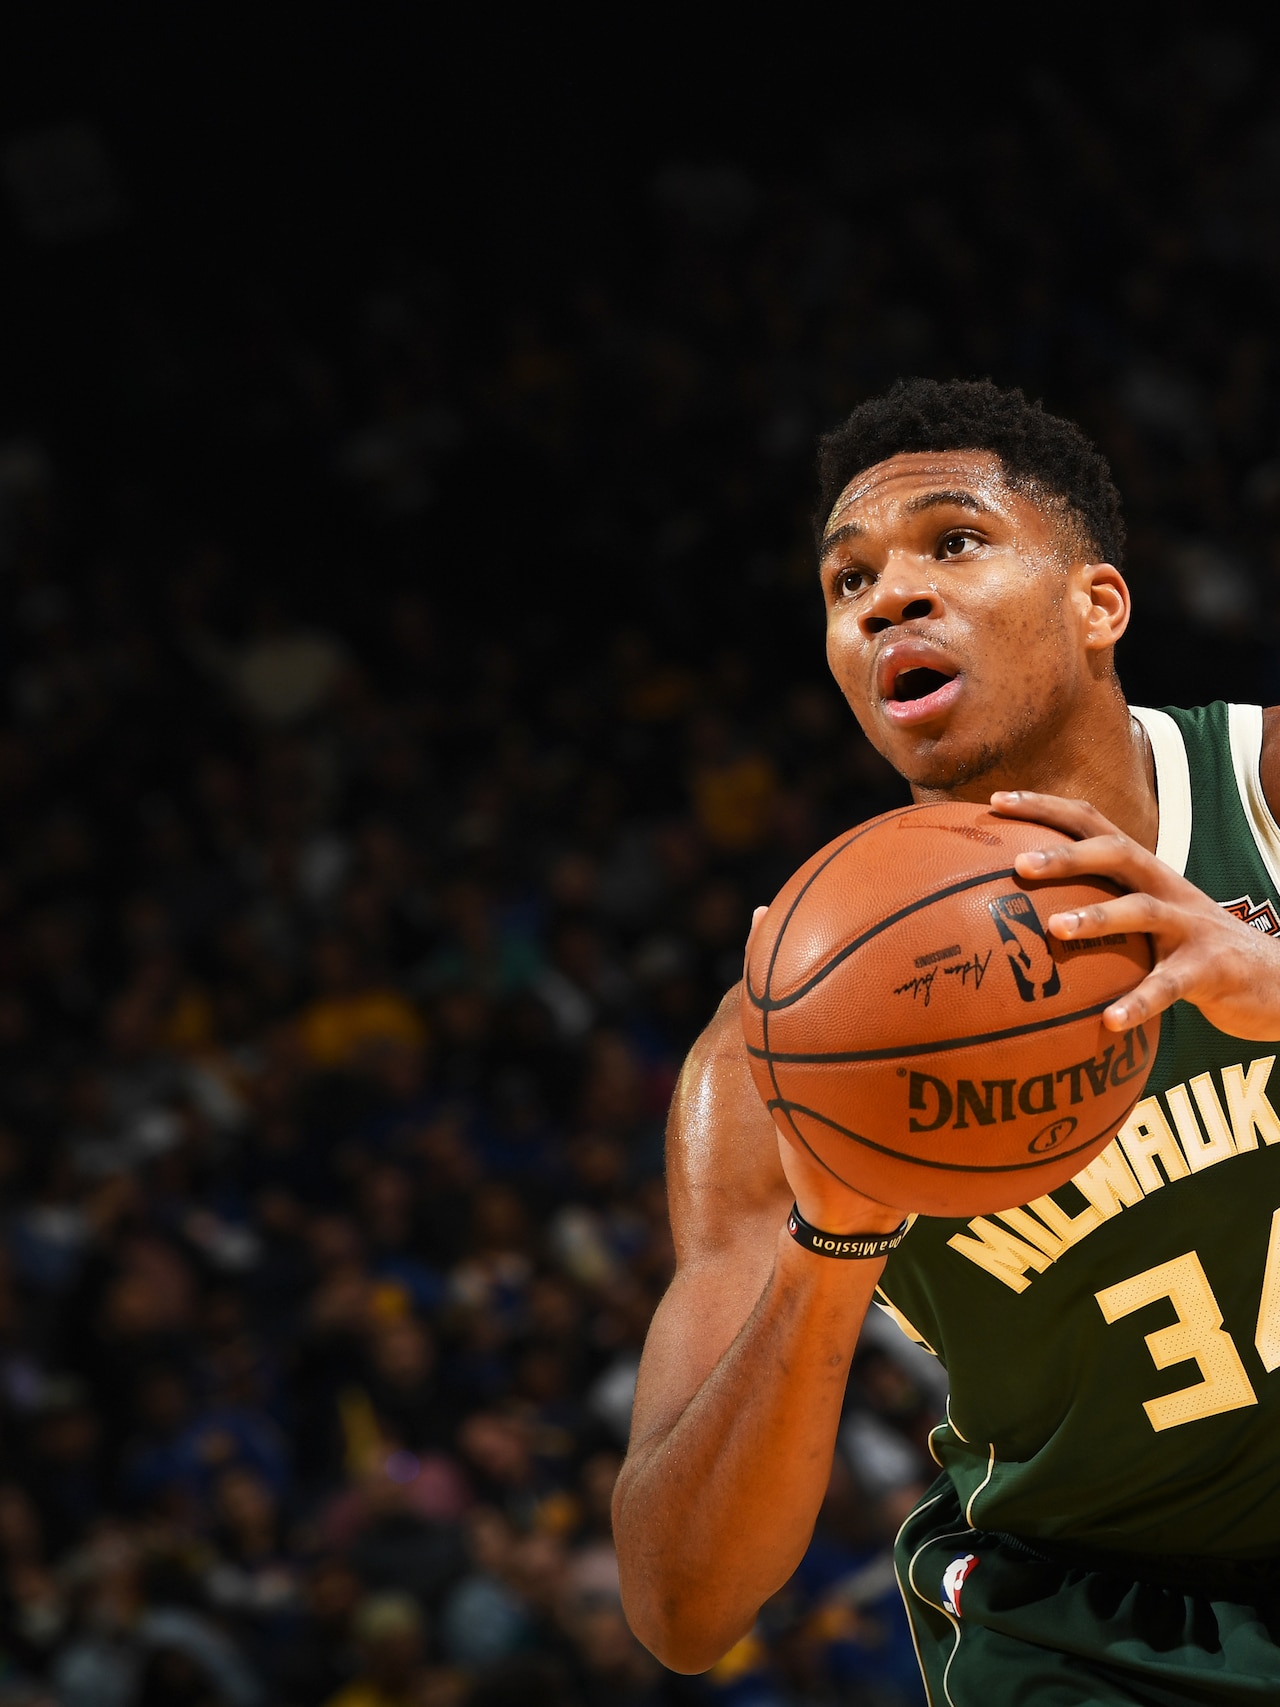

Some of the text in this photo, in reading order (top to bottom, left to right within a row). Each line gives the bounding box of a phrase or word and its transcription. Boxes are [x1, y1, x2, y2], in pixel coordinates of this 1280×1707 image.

[1004, 897, 1030, 916] NBA
[812, 1235, 878, 1256] Mission
[879, 1240, 888, 1251] a
